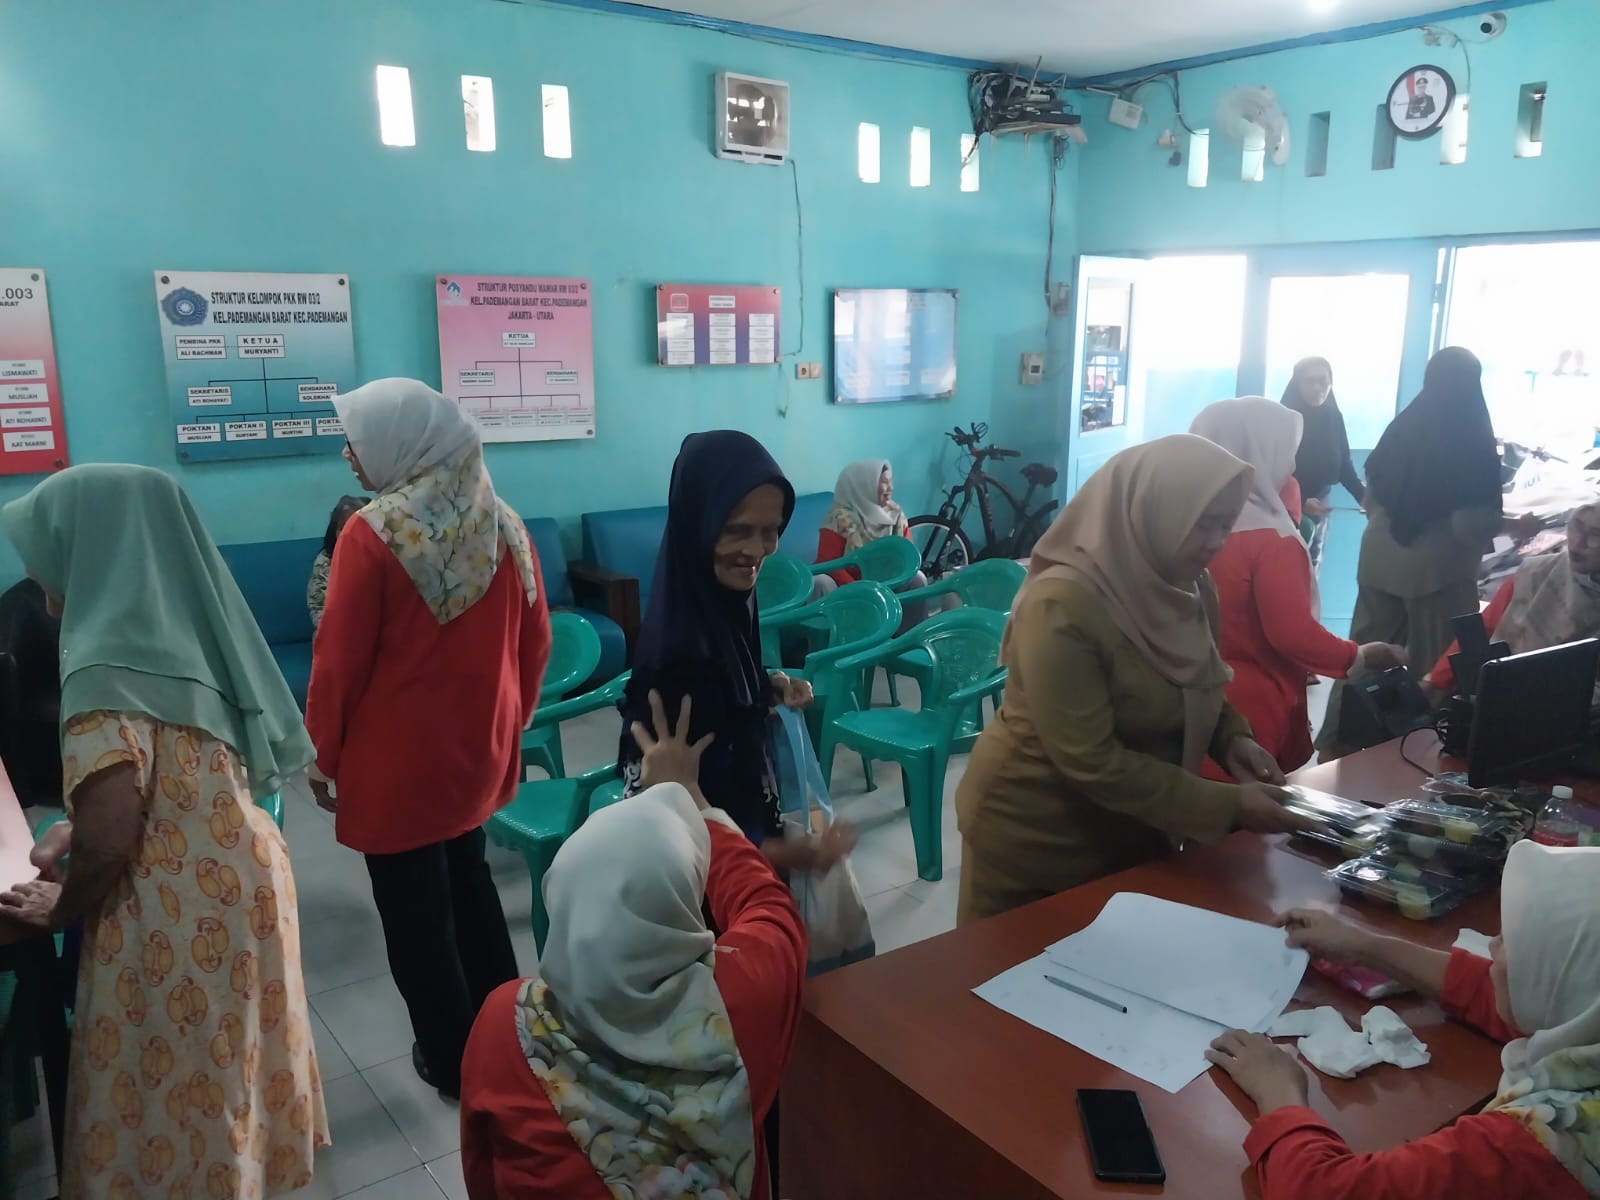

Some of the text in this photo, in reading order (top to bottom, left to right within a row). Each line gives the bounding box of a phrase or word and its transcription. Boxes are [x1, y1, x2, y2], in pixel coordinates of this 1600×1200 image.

[477, 282, 507, 292] STRUKTUR
[2, 287, 34, 300] .003
[211, 292, 246, 304] STRUKTUR
[247, 292, 282, 304] KELOMPOK
[283, 292, 296, 305] PKK
[297, 292, 307, 304] RW
[213, 311, 348, 323] KEL.PADEMANGAN BARAT KEC.PADEMANGAN
[507, 312, 533, 320] JAKARTA
[536, 312, 554, 320] UTARA
